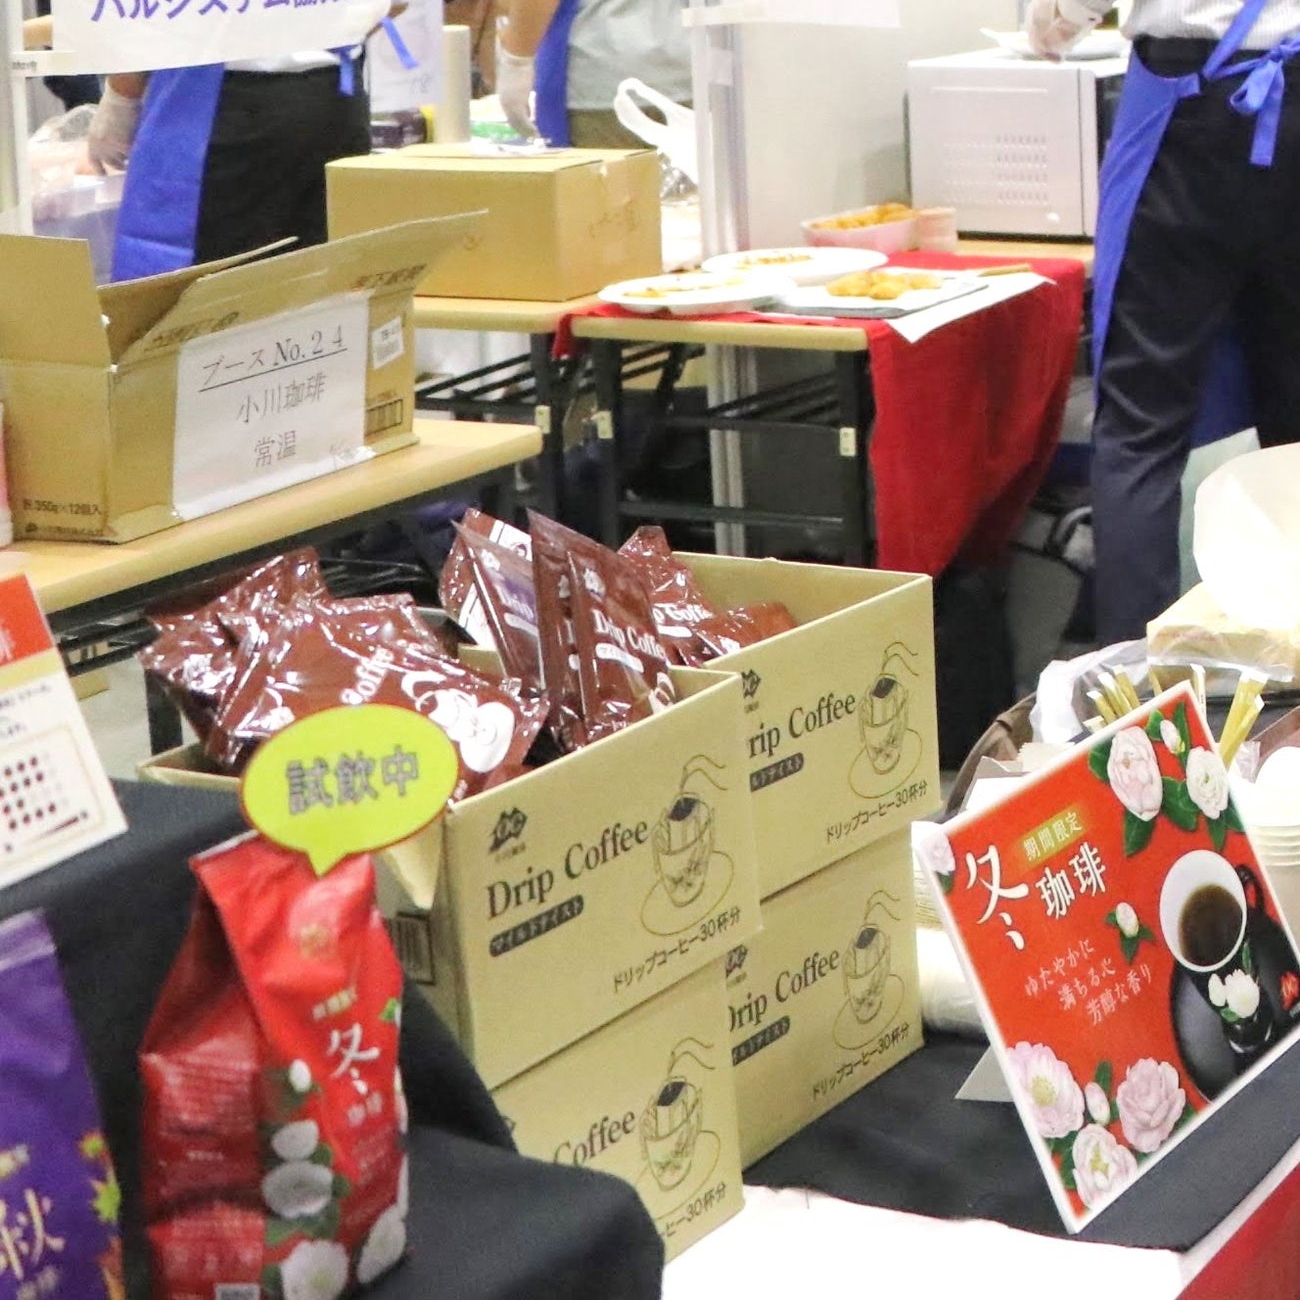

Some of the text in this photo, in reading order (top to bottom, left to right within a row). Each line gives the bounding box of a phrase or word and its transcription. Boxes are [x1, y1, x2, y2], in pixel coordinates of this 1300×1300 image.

[203, 354, 264, 386] ブース
[236, 371, 328, 424] 小川珈琲
[254, 430, 298, 469] 常温
[747, 692, 856, 758] rip Coffee
[286, 745, 419, 815] 試飲中
[826, 779, 928, 844] ドリップコーヒー30杯分
[1023, 811, 1083, 862] 期間限定
[485, 820, 650, 920] Drip Coffee
[965, 841, 1106, 950] 冬 珈琲
[613, 906, 742, 994] ドリップコーヒー30杯分
[775, 950, 840, 1003] Coffee
[1086, 964, 1151, 1026] 芳醇な香り
[326, 1021, 381, 1095] 冬
[812, 1021, 911, 1100] ドリップコーヒー30杯分
